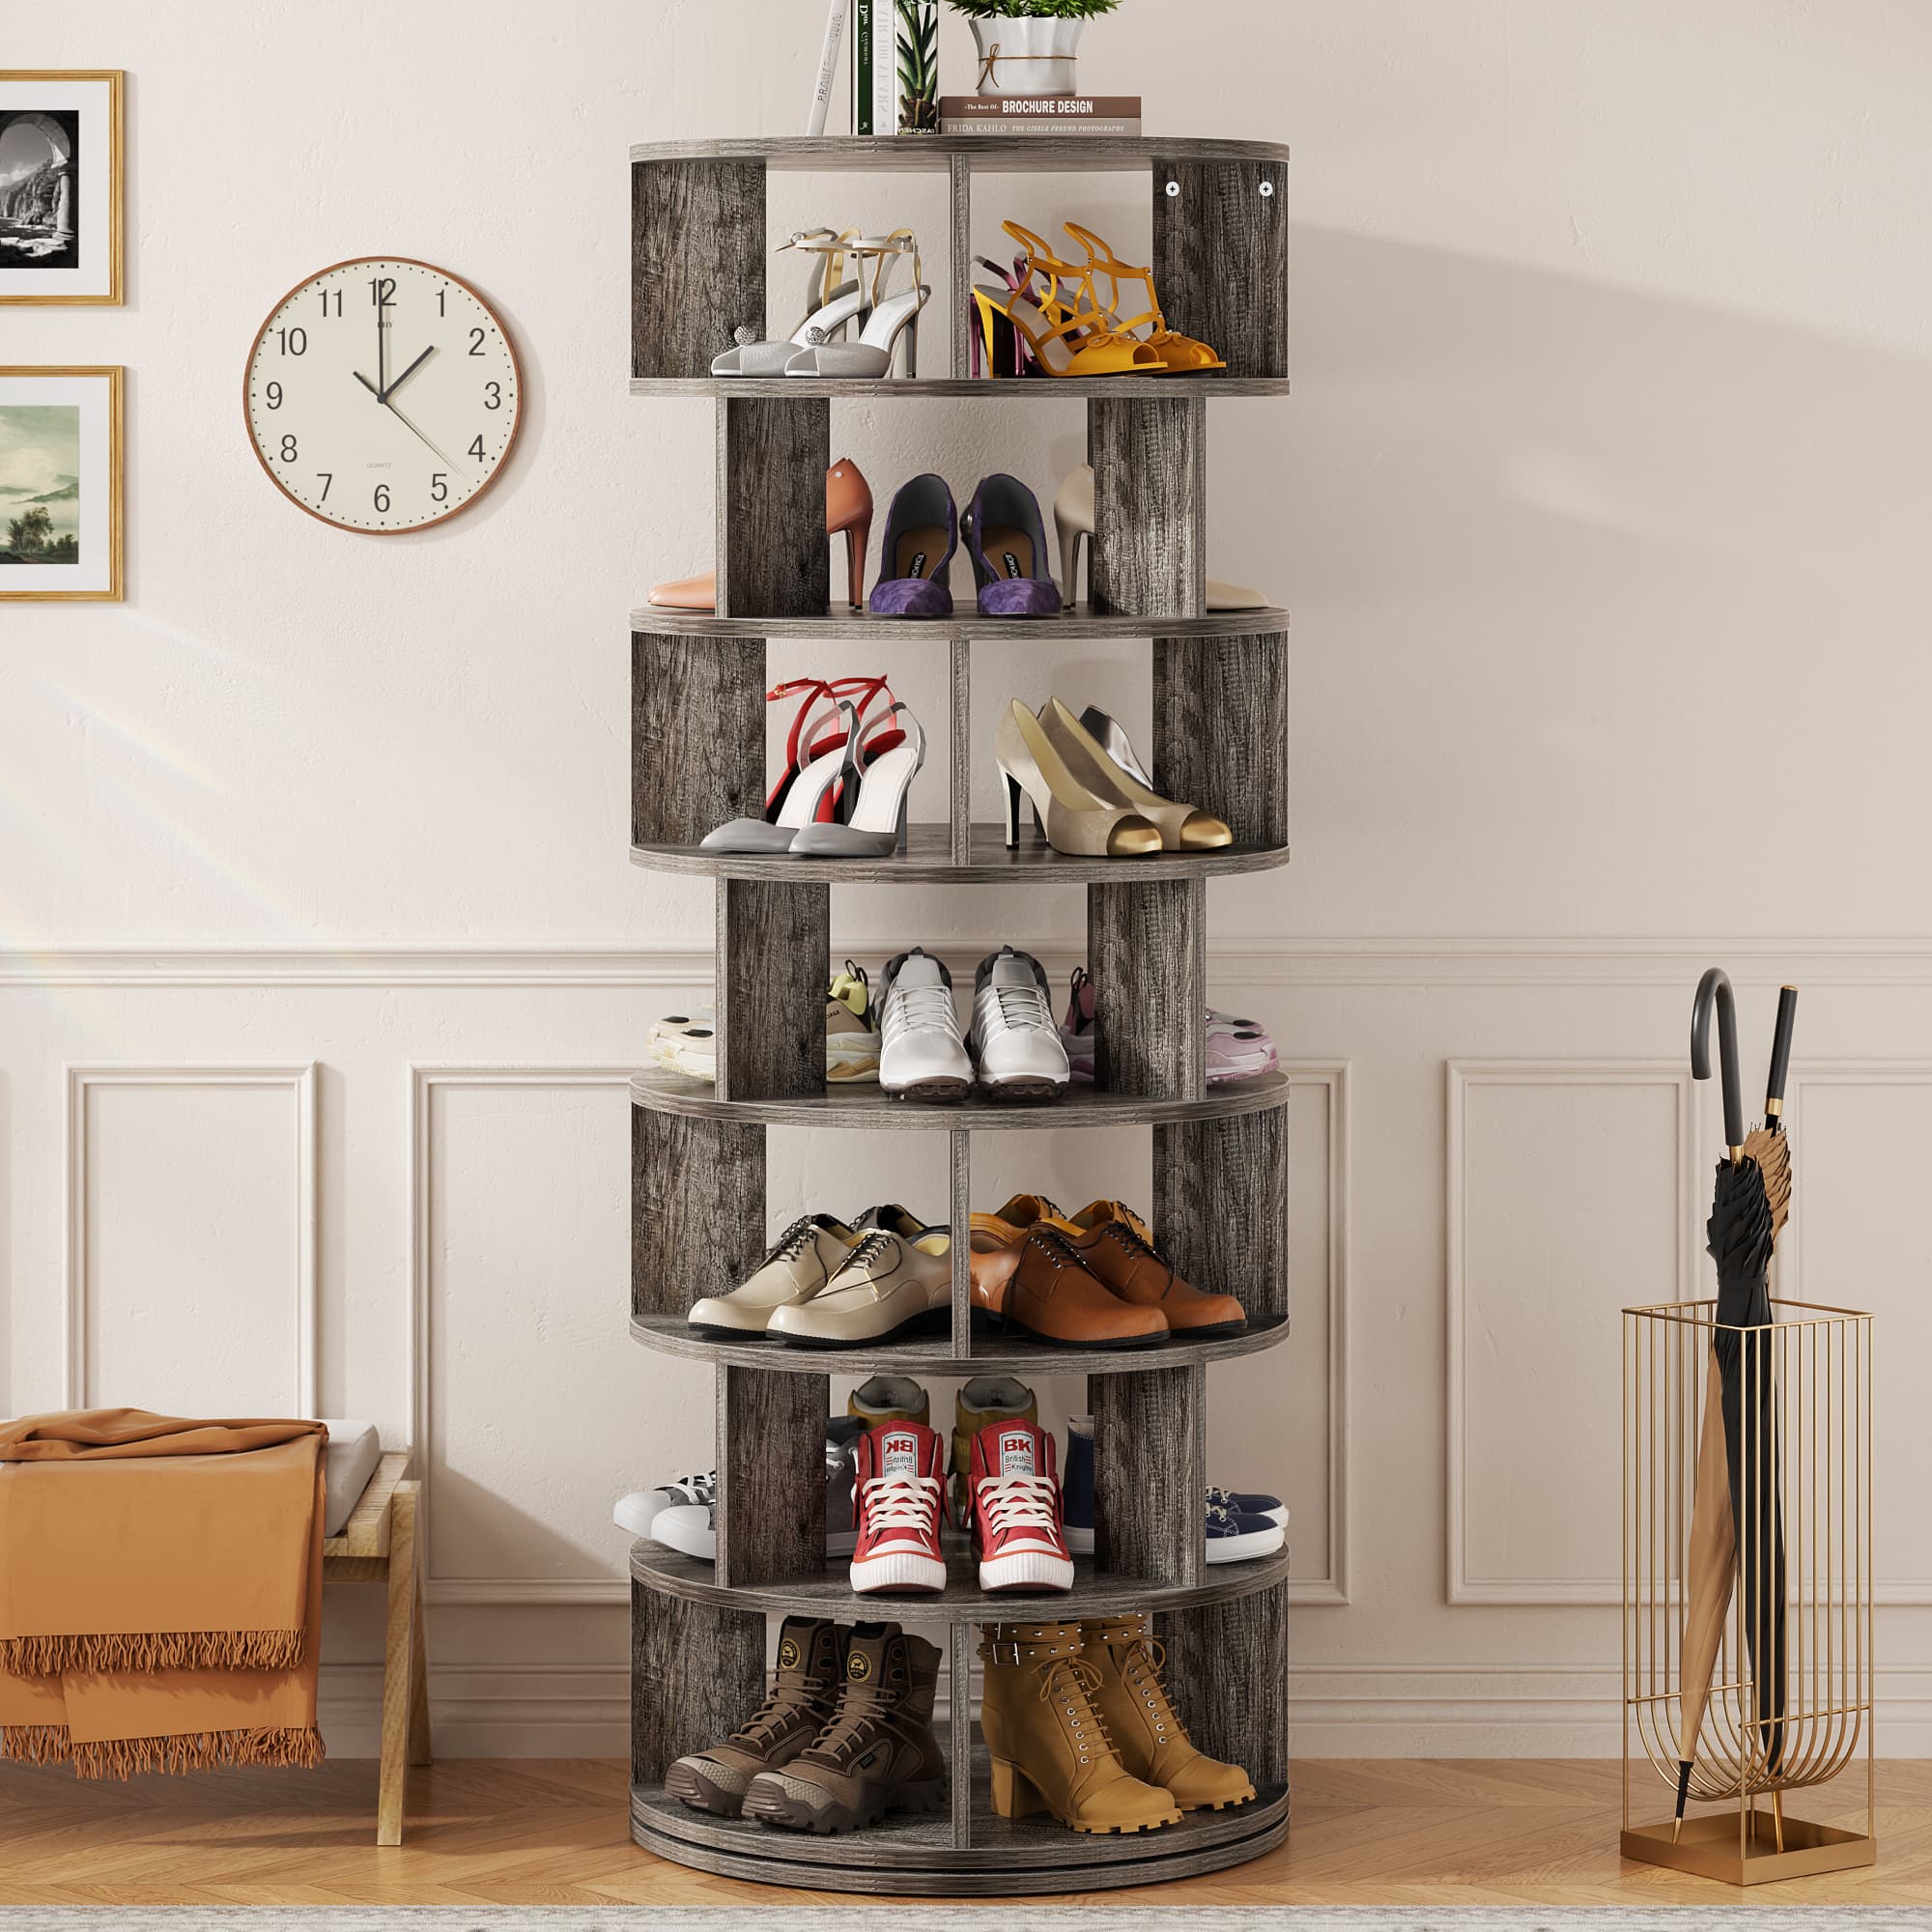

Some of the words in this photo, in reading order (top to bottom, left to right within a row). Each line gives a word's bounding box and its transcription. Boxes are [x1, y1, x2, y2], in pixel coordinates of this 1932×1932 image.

[1002, 99, 1056, 114] BROCHURE
[1057, 99, 1094, 114] DESIGN
[948, 124, 974, 132] FRIDA
[977, 124, 1007, 132] KAHLO
[318, 289, 343, 317] 11
[368, 277, 397, 306] 12
[436, 289, 445, 317] 1
[276, 327, 307, 355] 10
[469, 327, 486, 355] 2
[266, 382, 283, 410] 9
[484, 382, 501, 410] 3
[280, 434, 298, 462] 8
[468, 434, 486, 462] 4
[316, 473, 332, 501] 7
[374, 485, 390, 513] 6
[430, 473, 447, 501] 5
[1005, 1438, 1031, 1453] BK
[1005, 1454, 1026, 1463] British
